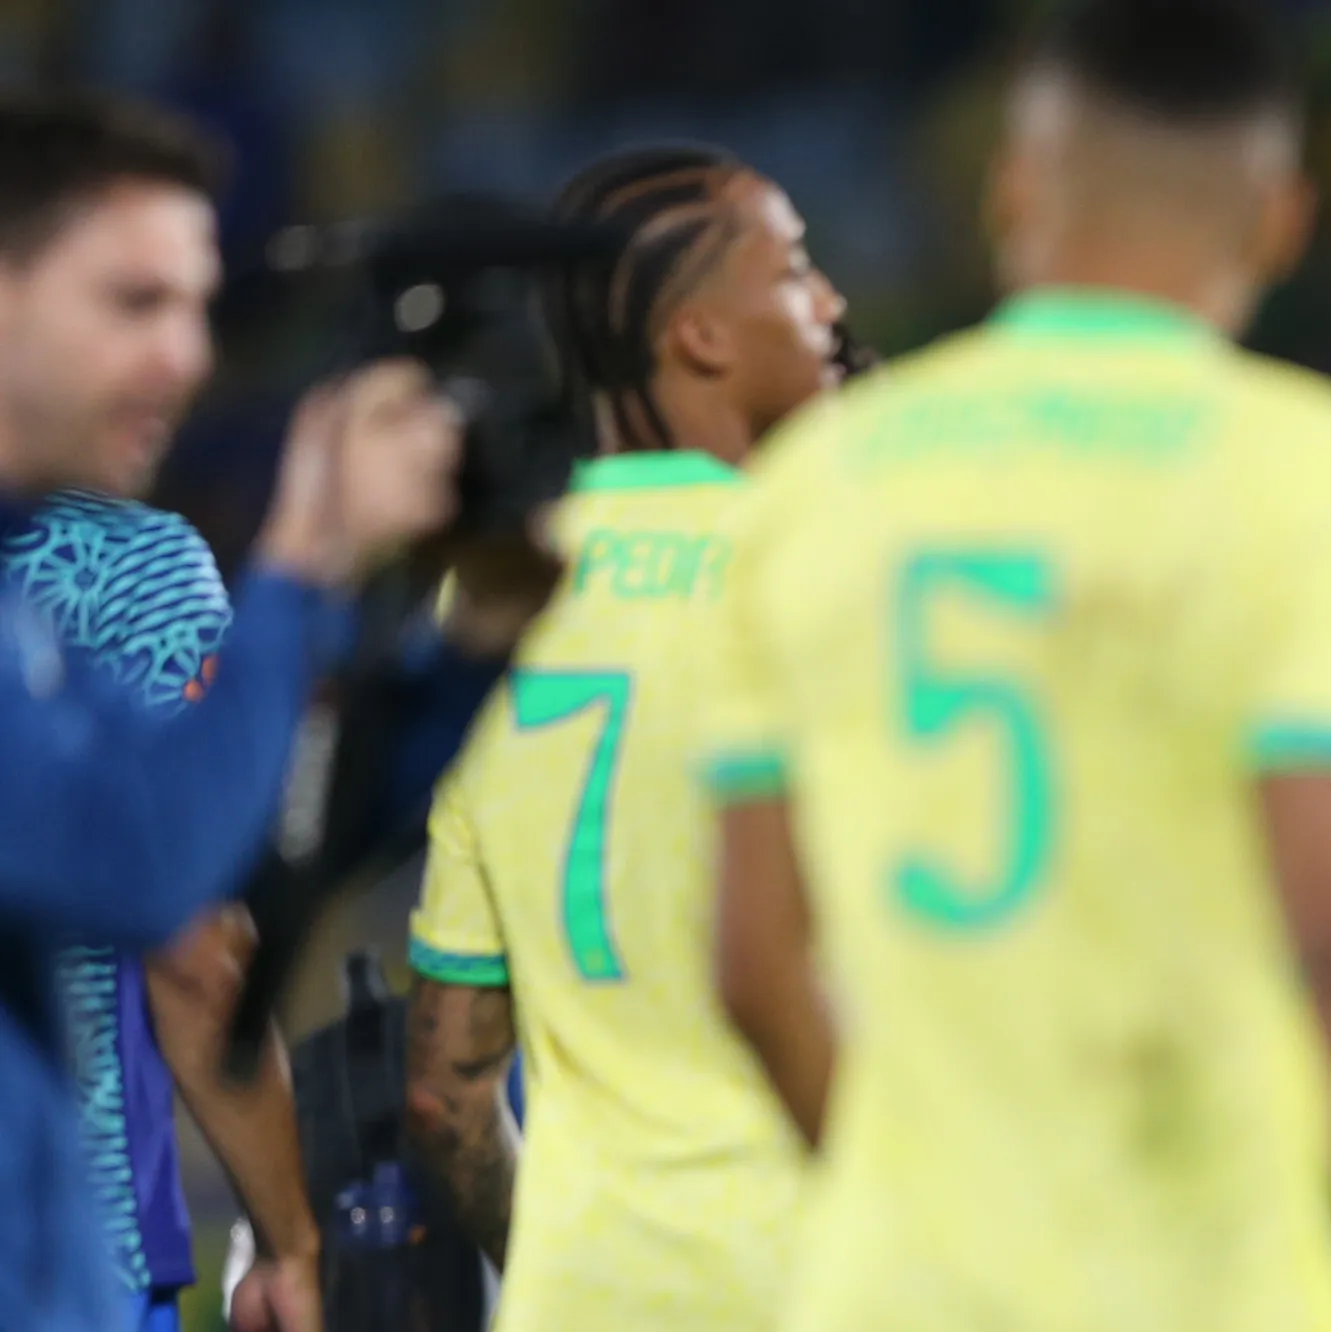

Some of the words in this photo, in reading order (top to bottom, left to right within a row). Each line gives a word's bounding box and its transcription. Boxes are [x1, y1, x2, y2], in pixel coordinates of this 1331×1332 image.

[572, 525, 736, 602] PEDR
[512, 669, 630, 981] 7
[890, 546, 1052, 928] 5
